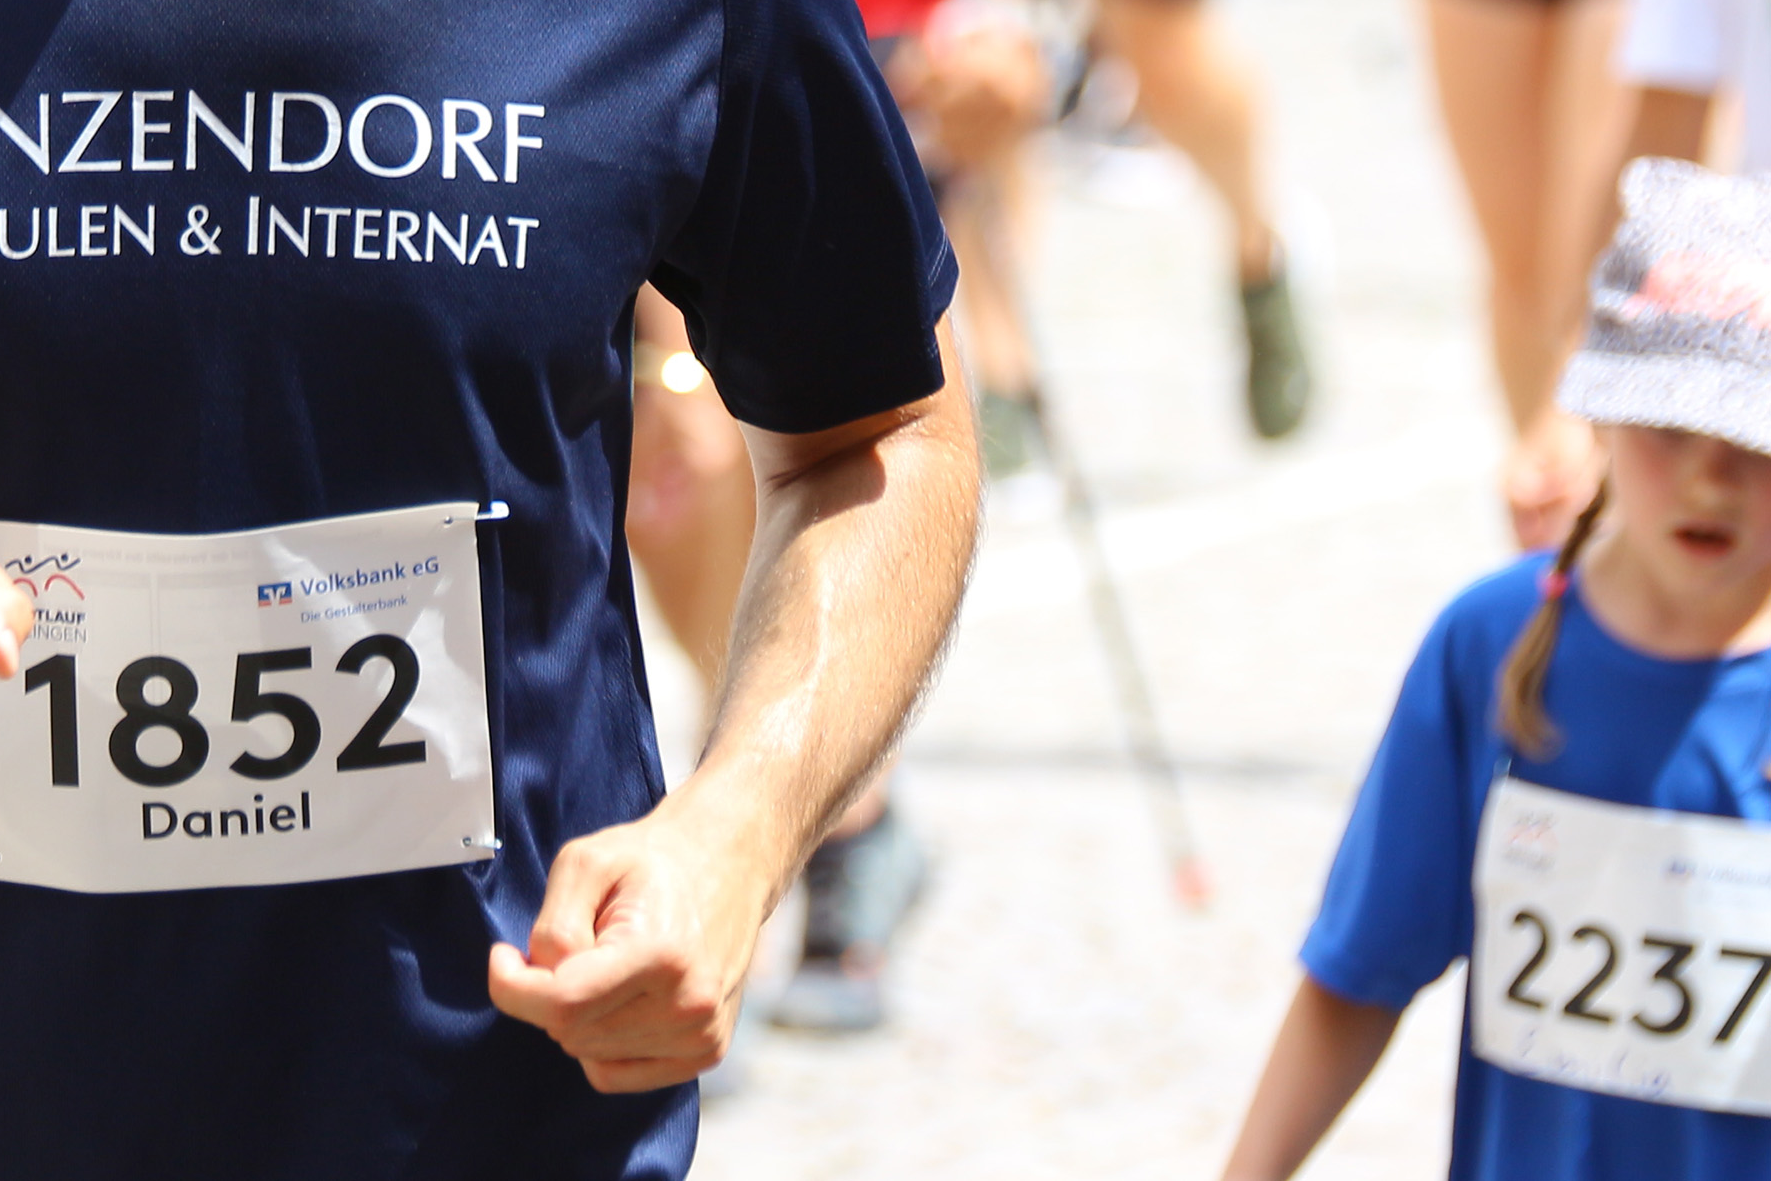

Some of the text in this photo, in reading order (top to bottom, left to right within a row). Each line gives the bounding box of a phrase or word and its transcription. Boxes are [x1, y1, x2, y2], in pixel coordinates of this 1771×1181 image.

[179, 204, 222, 257] &
[300, 556, 440, 596] Volksbank eG
[33, 608, 86, 625] TLAUF
[300, 596, 408, 624] Die Gestalterbank
[28, 624, 87, 643] INGEN
[25, 634, 427, 787] 1852
[142, 791, 311, 840] Daniel
[1506, 911, 1771, 1045] 2237
